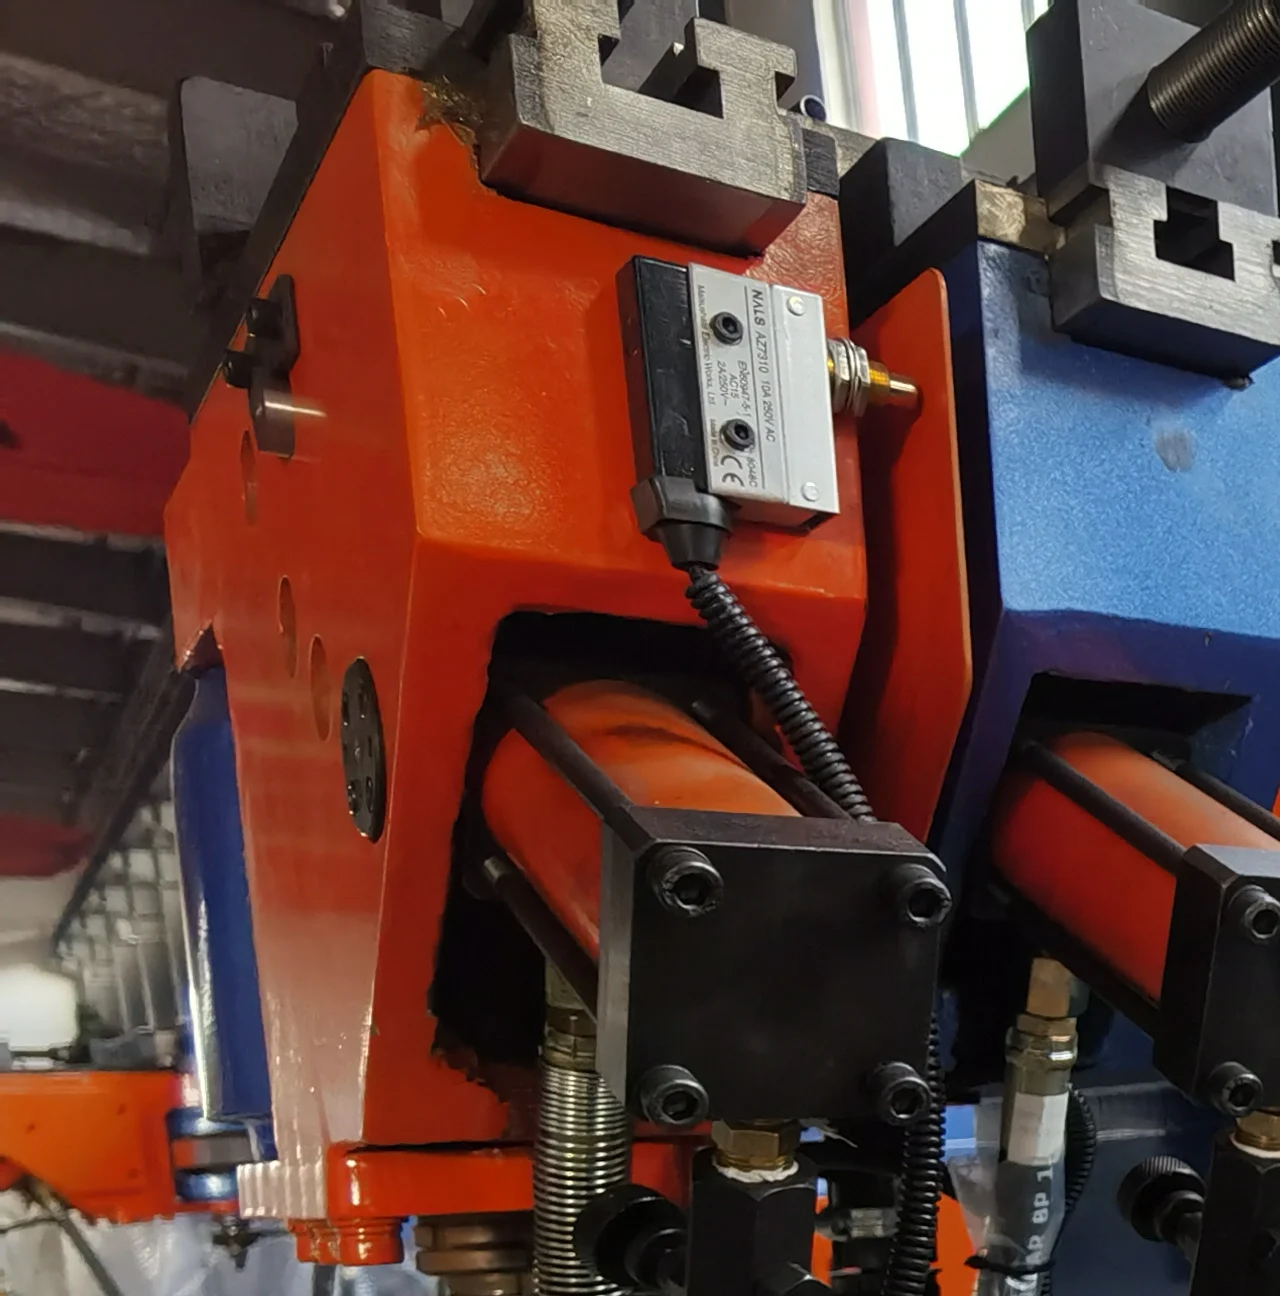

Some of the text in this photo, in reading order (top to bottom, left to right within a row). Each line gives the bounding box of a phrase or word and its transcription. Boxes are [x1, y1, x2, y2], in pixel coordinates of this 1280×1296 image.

[755, 331, 769, 374] AZ7310
[728, 373, 740, 400] AC15
[761, 380, 772, 398] 10A
[763, 400, 775, 427] 250V
[765, 427, 776, 443] AC
